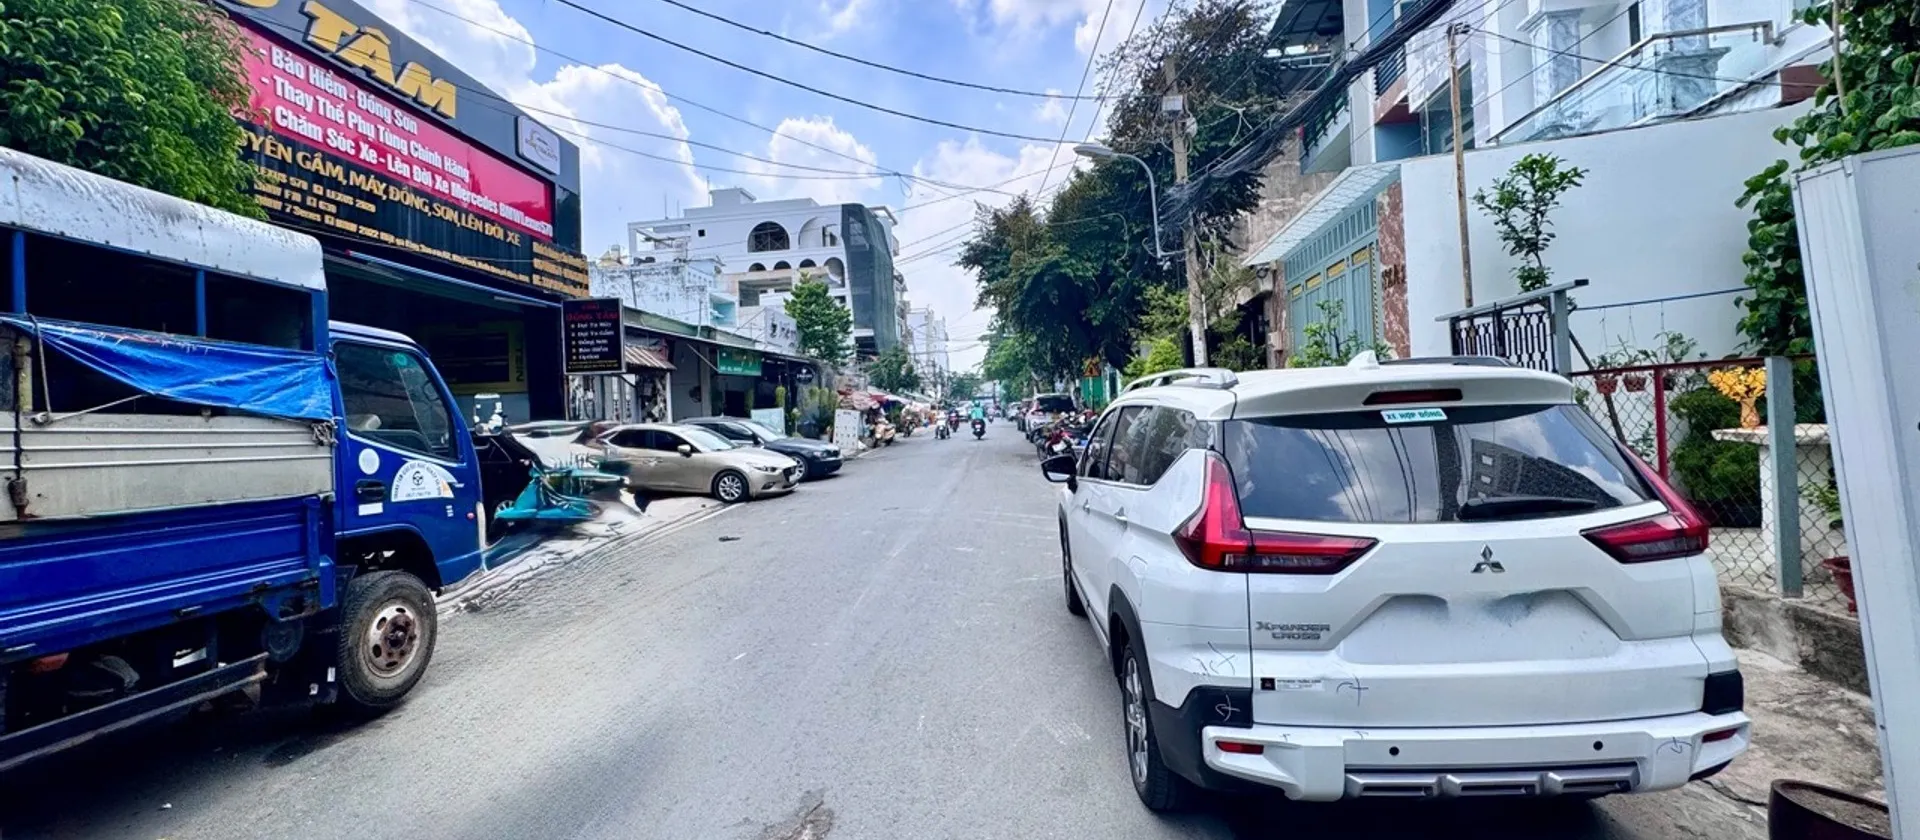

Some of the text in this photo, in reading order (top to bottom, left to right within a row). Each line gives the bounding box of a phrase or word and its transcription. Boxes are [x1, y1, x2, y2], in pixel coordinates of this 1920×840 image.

[271, 45, 305, 80] Bảo
[308, 65, 348, 101] Hiểm
[356, 88, 392, 125] Đồng
[393, 109, 418, 136] Sơn
[303, 0, 457, 119] TÂM
[273, 75, 314, 112] Thay
[315, 95, 345, 124] Thế
[347, 110, 376, 141] Phụ
[376, 123, 409, 156] Tùng
[410, 140, 443, 169] Chính
[443, 155, 470, 184] Hãng
[275, 105, 323, 143] Chăm
[326, 127, 356, 156] Sóc
[359, 141, 378, 165] Xe
[387, 153, 411, 180] Lên
[412, 165, 432, 188] Đời
[434, 173, 449, 195] Xe
[450, 180, 498, 215] Mercedes
[349, 170, 386, 200] MÁY,
[461, 212, 483, 233] LÊN
[506, 230, 521, 247] XE
[1272, 632, 1321, 640] CROSS
